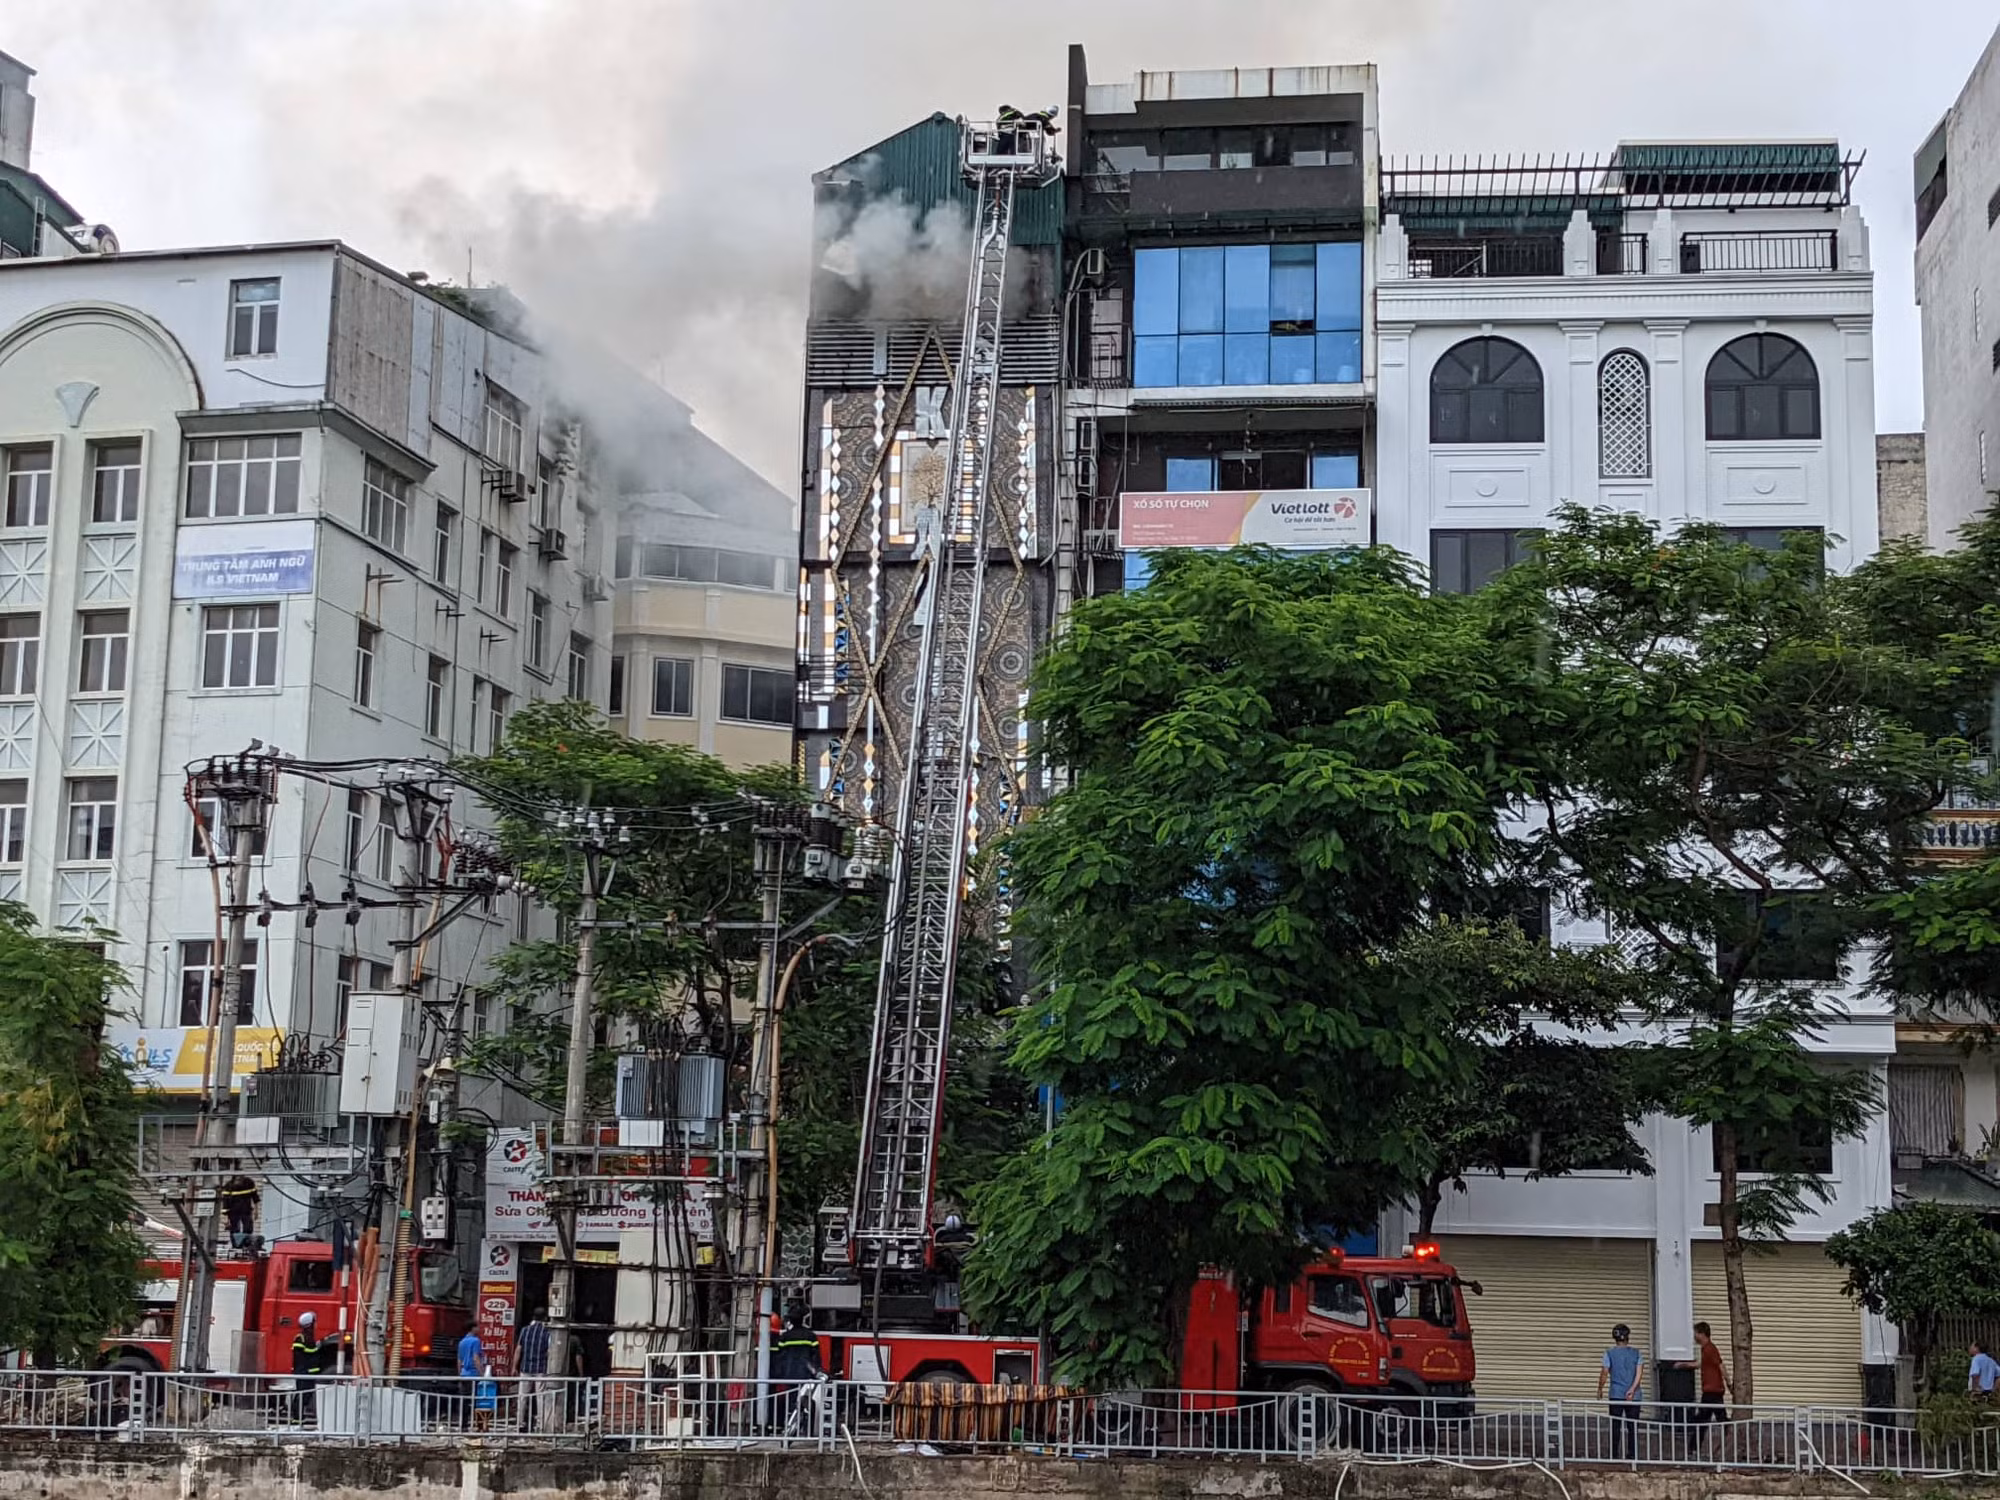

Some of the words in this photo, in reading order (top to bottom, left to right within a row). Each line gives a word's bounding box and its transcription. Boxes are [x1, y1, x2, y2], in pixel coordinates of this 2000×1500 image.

[1271, 503, 1330, 515] Vietlott
[250, 557, 277, 570] ANH
[227, 572, 279, 584] VIETNAM
[495, 1204, 521, 1216] Sửa
